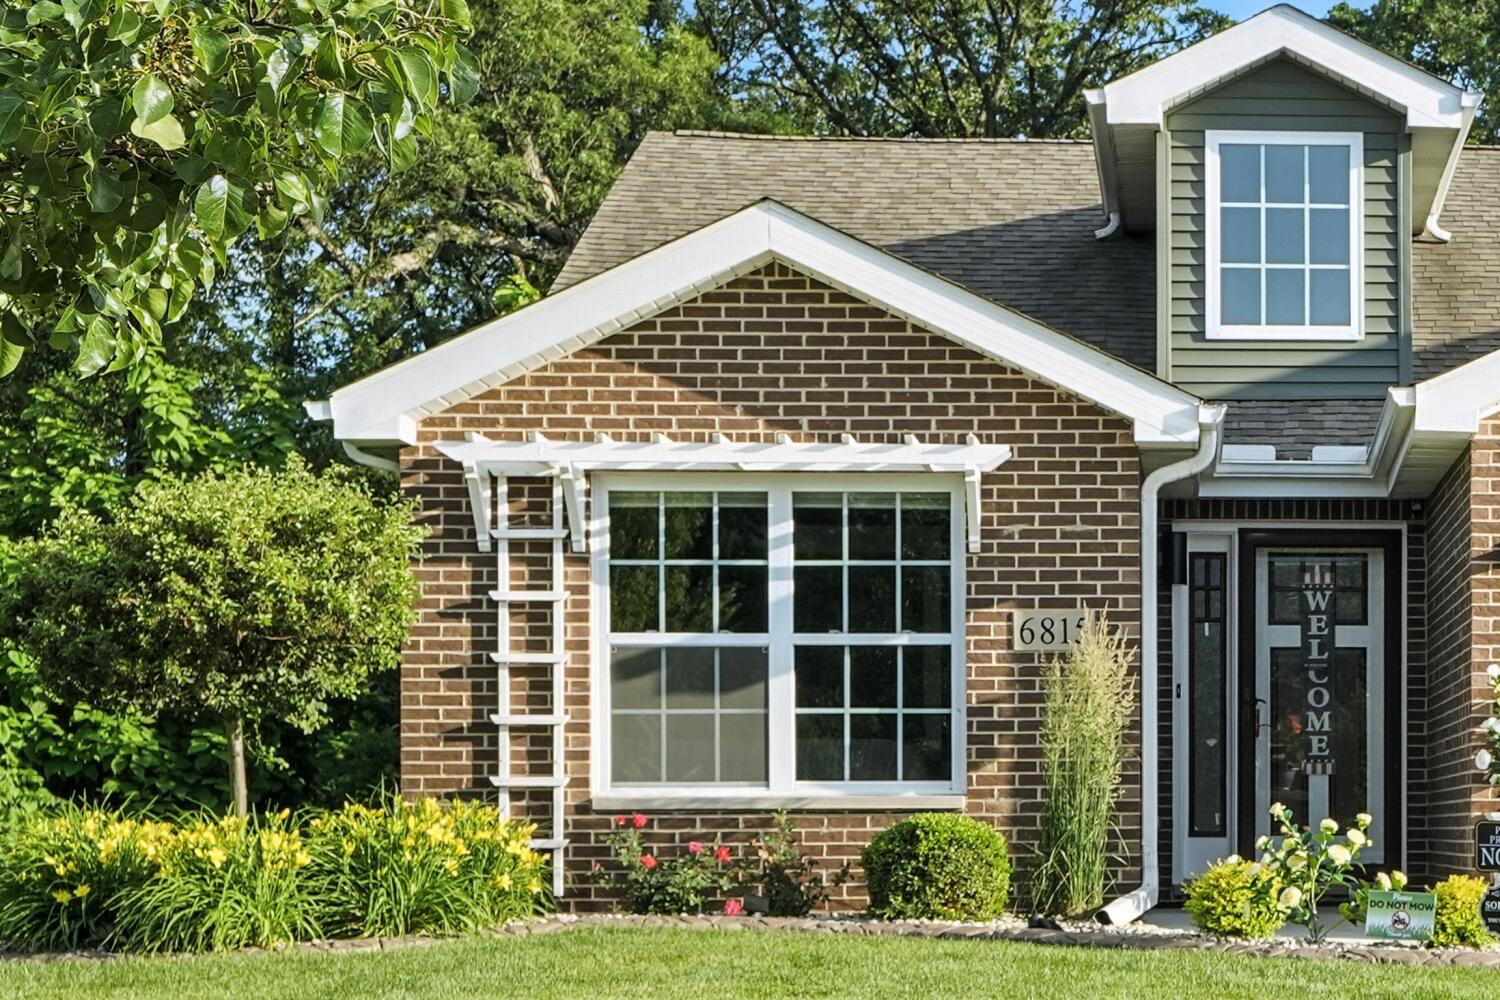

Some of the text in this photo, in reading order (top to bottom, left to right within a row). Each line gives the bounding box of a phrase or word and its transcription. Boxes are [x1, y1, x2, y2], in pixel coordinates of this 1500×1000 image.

[1304, 591, 1333, 756] WELCOME
[1369, 900, 1435, 911] DO NOT MOW
